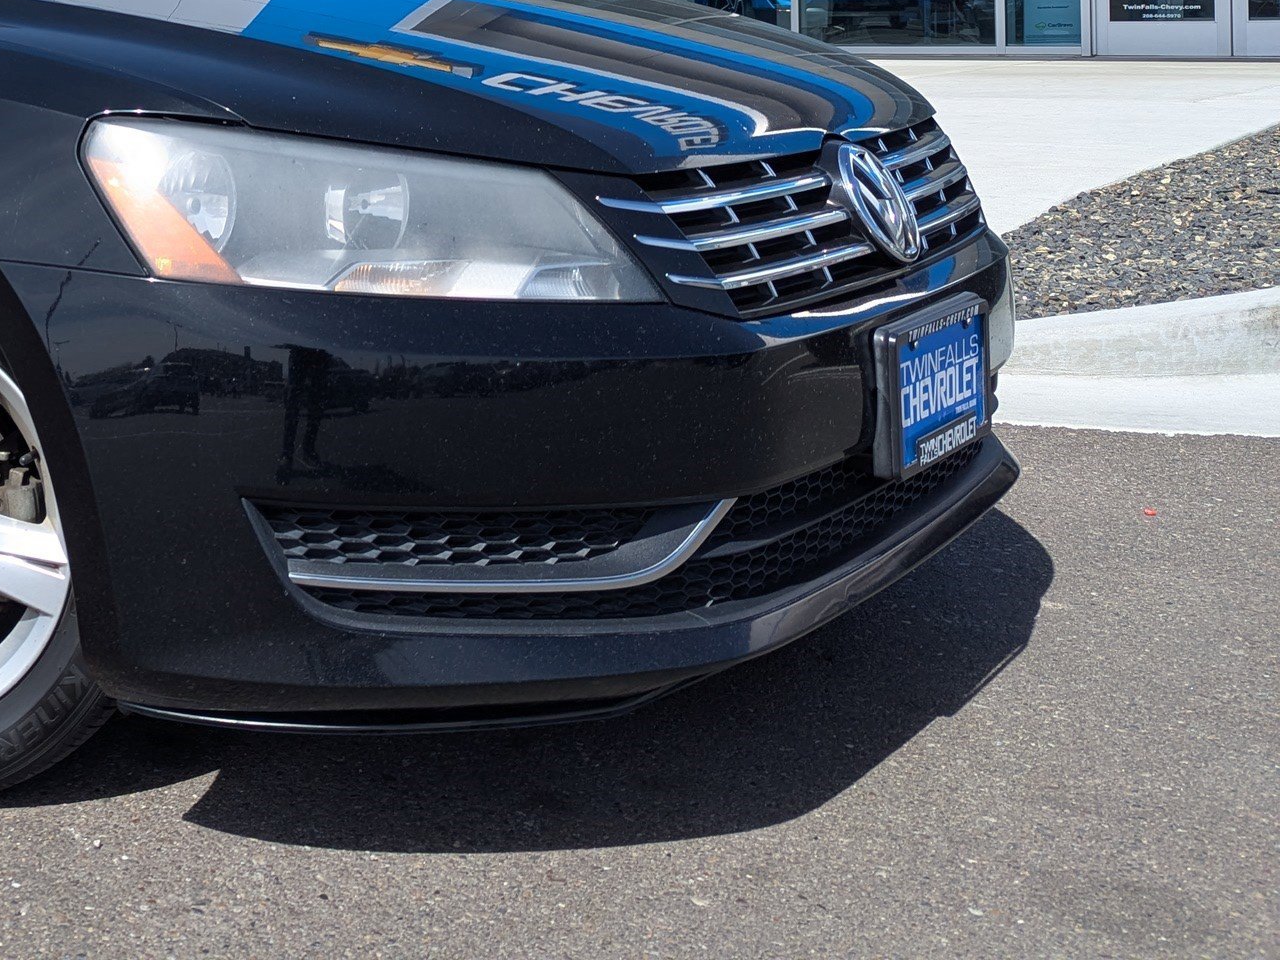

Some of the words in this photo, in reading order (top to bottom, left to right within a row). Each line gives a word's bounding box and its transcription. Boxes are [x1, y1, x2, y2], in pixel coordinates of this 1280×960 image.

[1123, 3, 1201, 11] TwinFalls-Chevy.com
[900, 333, 979, 386] TWINFALLS
[900, 356, 979, 429] CHEVROLET
[920, 436, 938, 458] TWIN
[937, 416, 977, 456] CHEVROLET
[920, 448, 939, 467] FALLS
